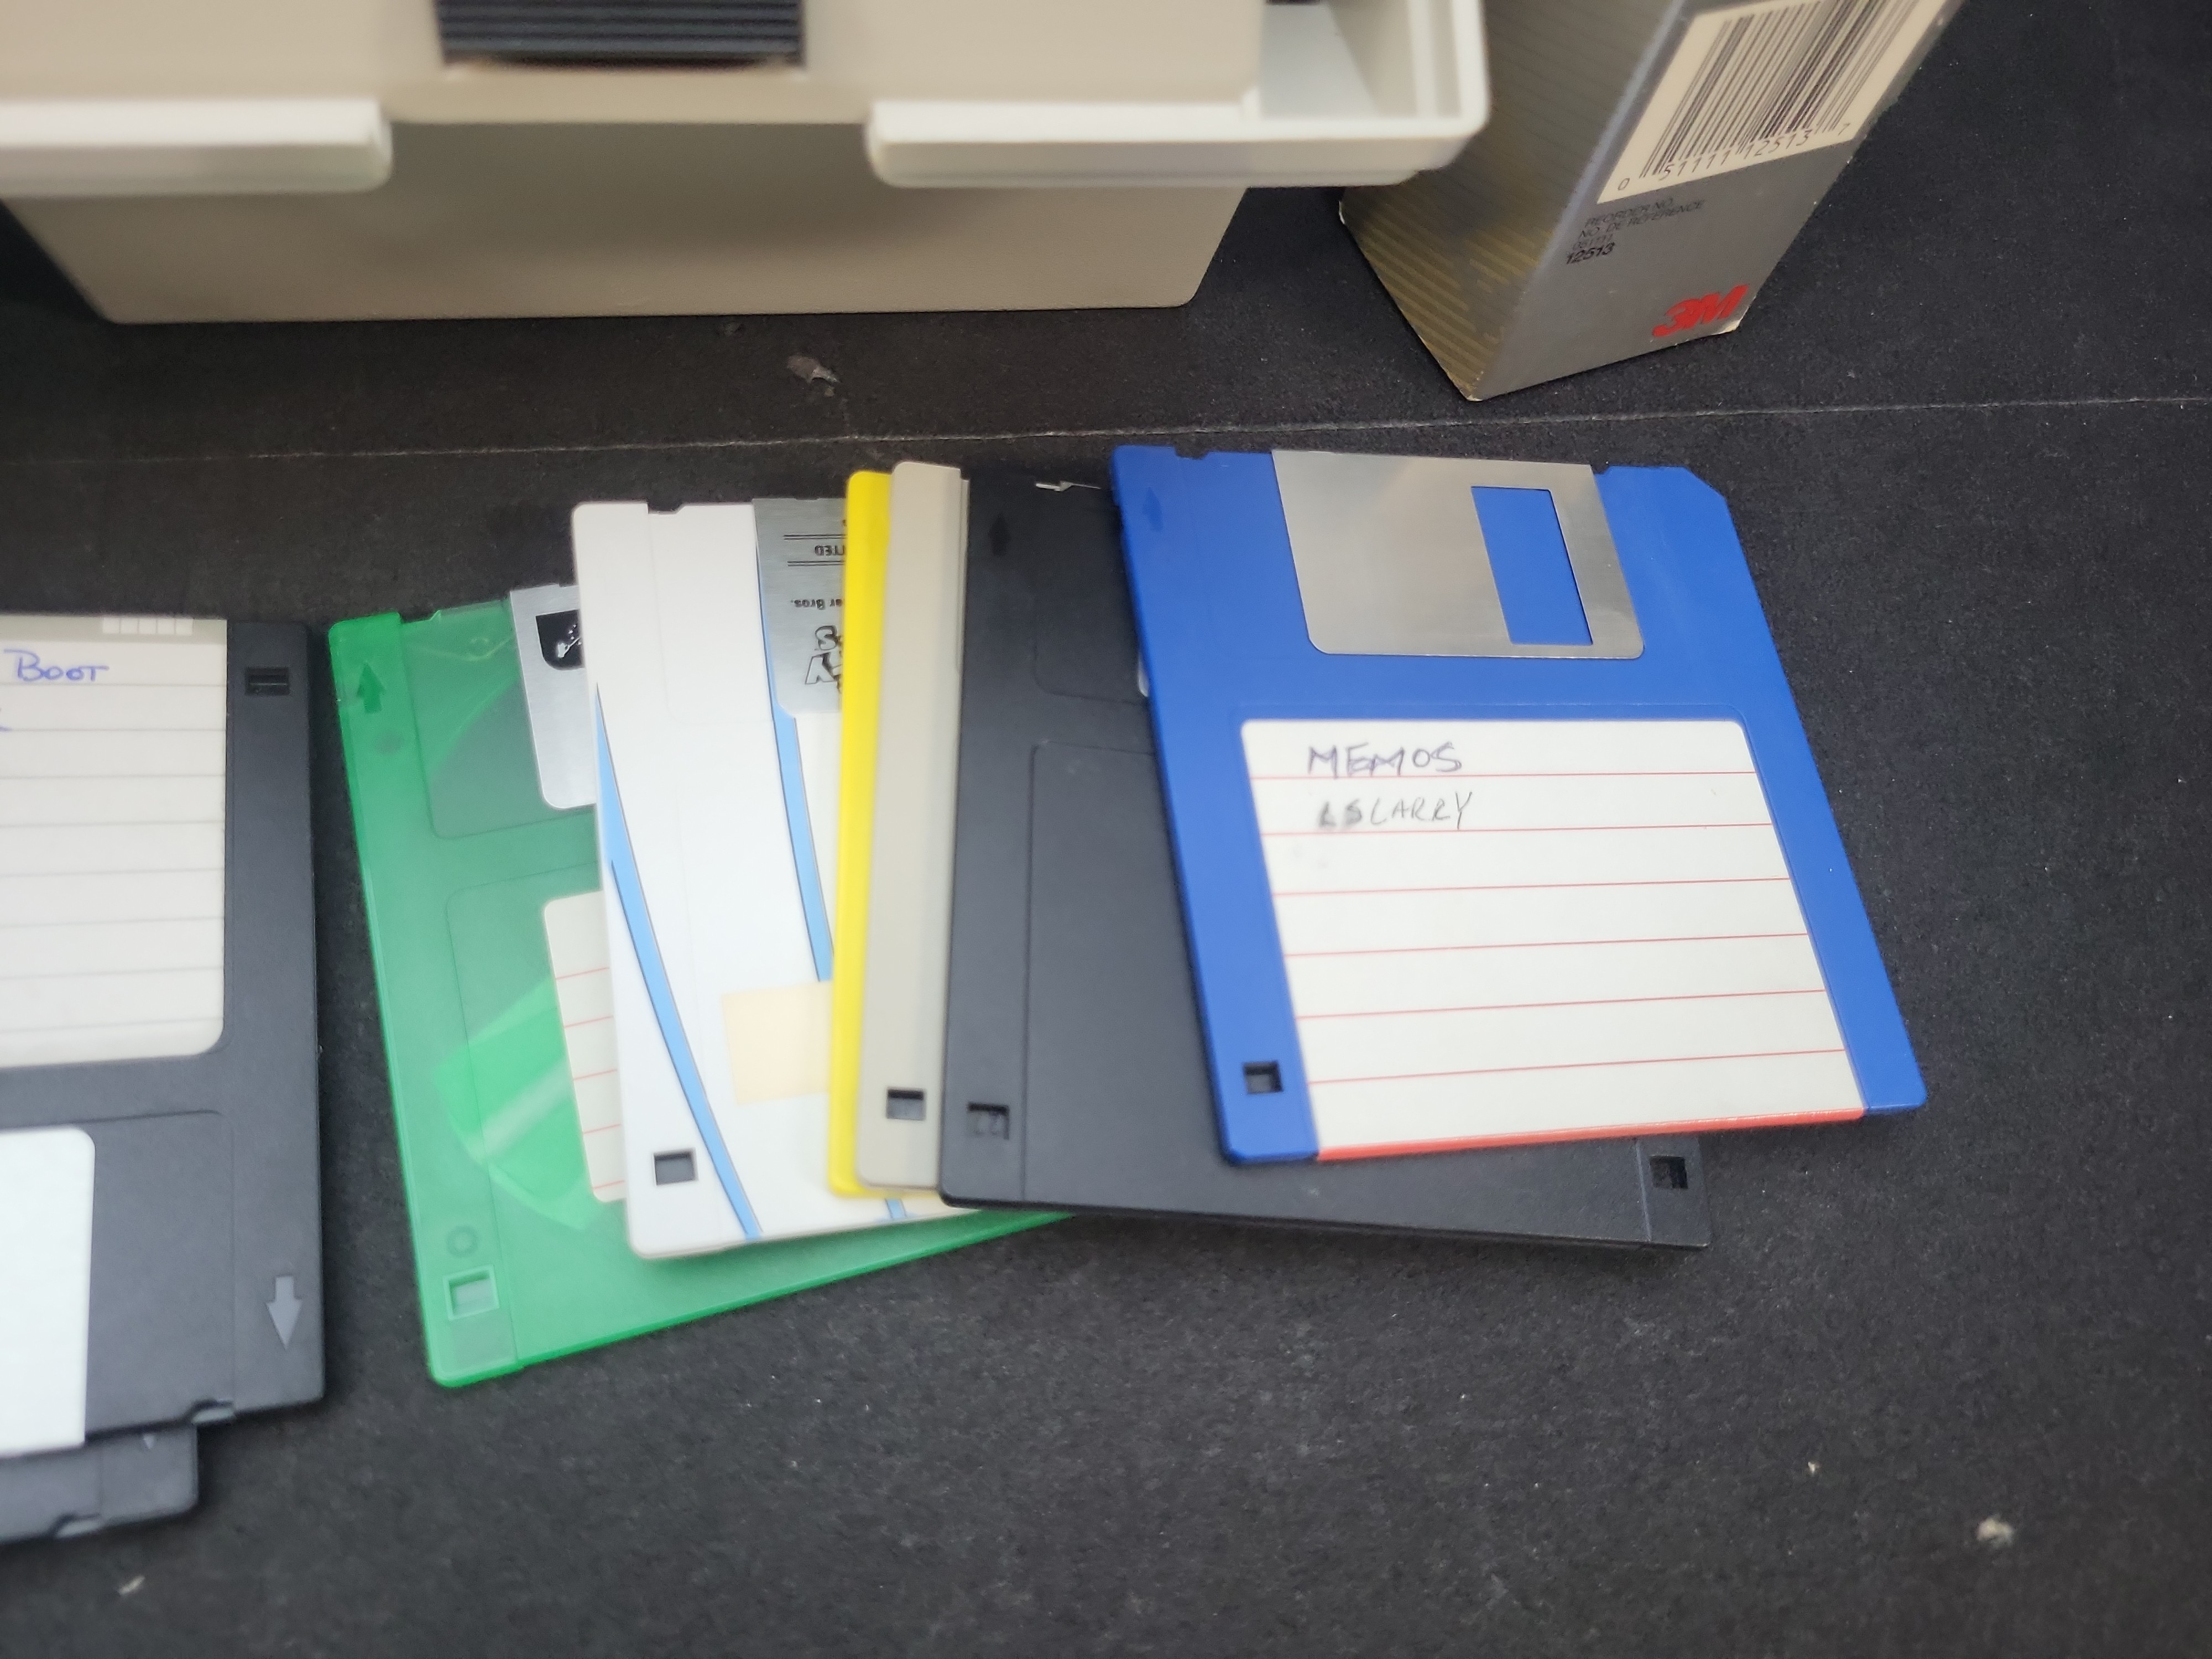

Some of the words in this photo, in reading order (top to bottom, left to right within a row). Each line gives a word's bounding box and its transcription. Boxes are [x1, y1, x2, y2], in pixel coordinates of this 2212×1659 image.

[1618, 177, 1630, 191] 0
[1659, 149, 1732, 181] 51111
[1743, 128, 1812, 159] 12513
[1837, 122, 1852, 137] 7
[1566, 242, 1615, 264] 12513
[1652, 285, 1749, 336] 3M
[791, 598, 826, 611] Bros.
[1307, 742, 1462, 779] MEMOS
